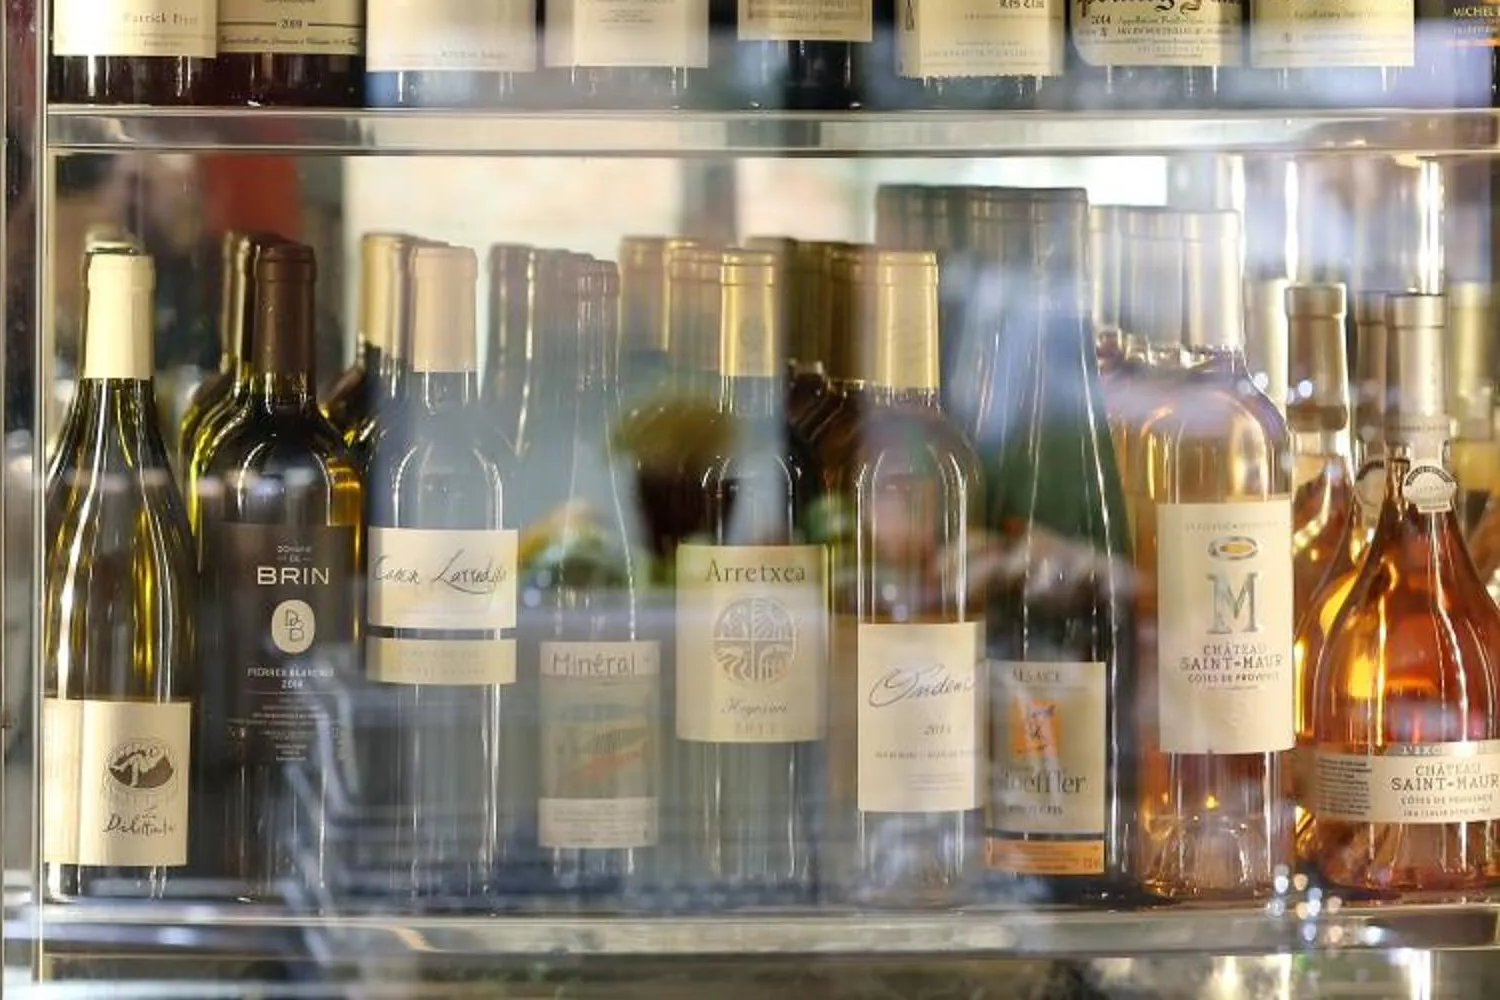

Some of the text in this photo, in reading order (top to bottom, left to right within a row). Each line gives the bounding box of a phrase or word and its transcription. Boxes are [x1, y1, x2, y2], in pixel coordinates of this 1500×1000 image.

[256, 565, 331, 586] BRIN
[705, 557, 806, 584] Arretxea
[1205, 572, 1258, 636] M
[552, 651, 636, 679] Minéral
[1011, 666, 1063, 683] ALSACE
